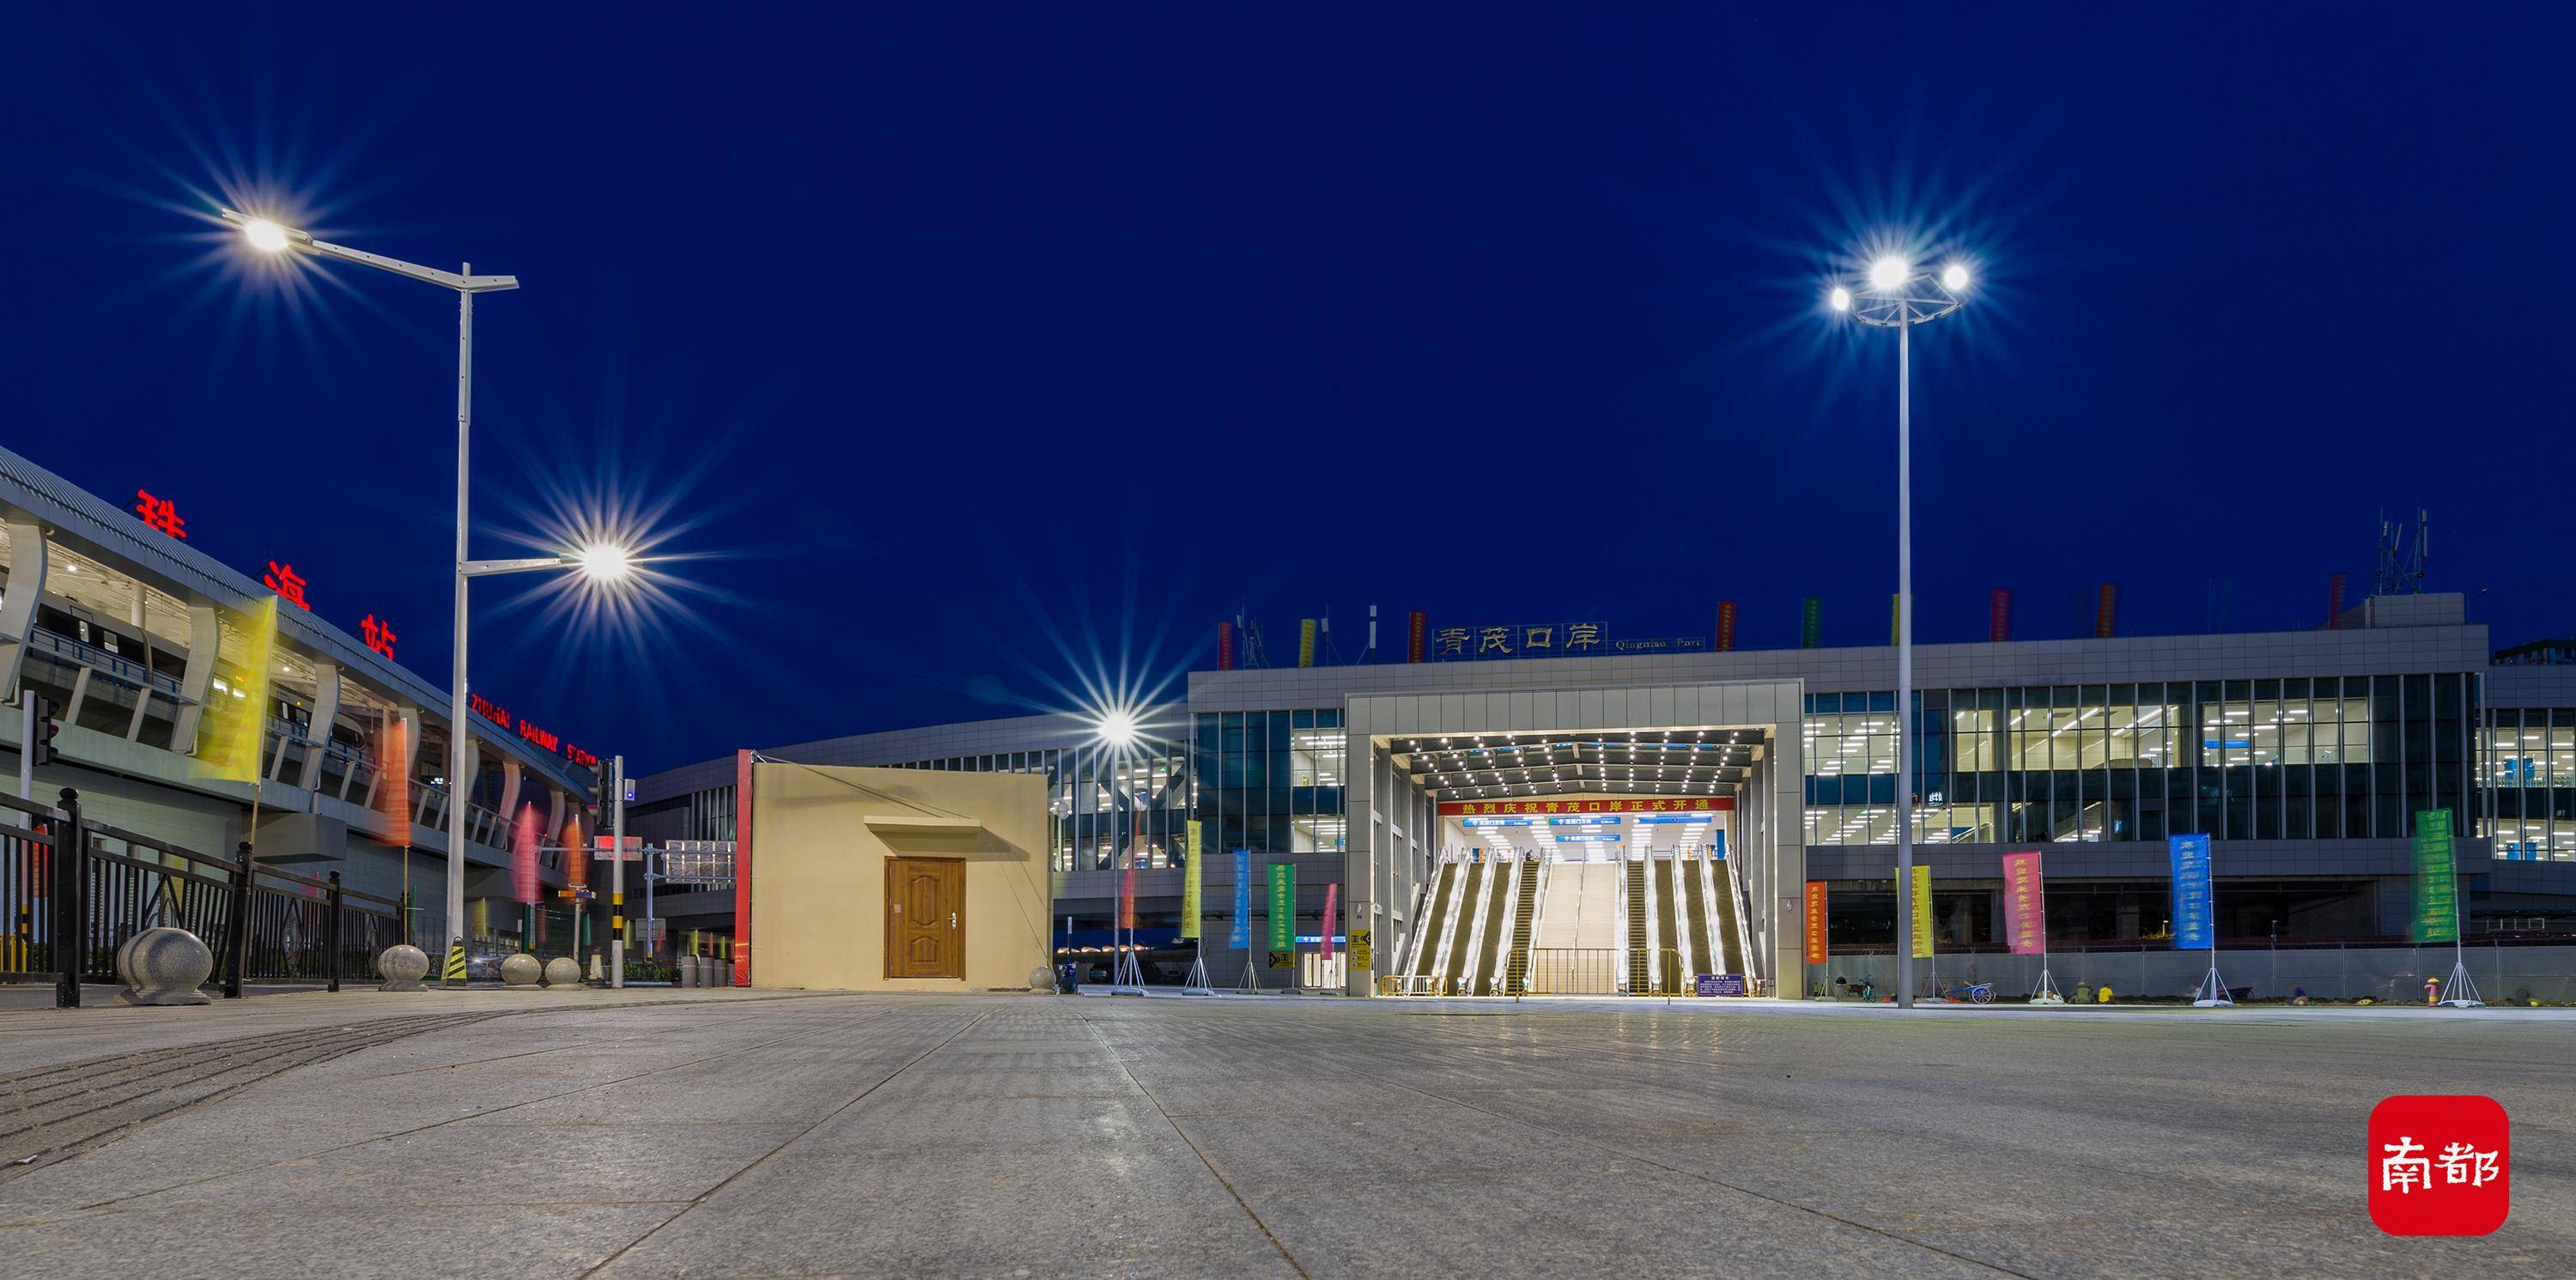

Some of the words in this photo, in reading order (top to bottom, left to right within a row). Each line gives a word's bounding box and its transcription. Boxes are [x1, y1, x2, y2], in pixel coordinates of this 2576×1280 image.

[1436, 623, 1601, 655] 青茂口岸
[1676, 638, 1701, 646] Port
[519, 719, 558, 752] RAILWAY
[1462, 798, 1710, 814] 热烈庆祝青茂口岸正式开通
